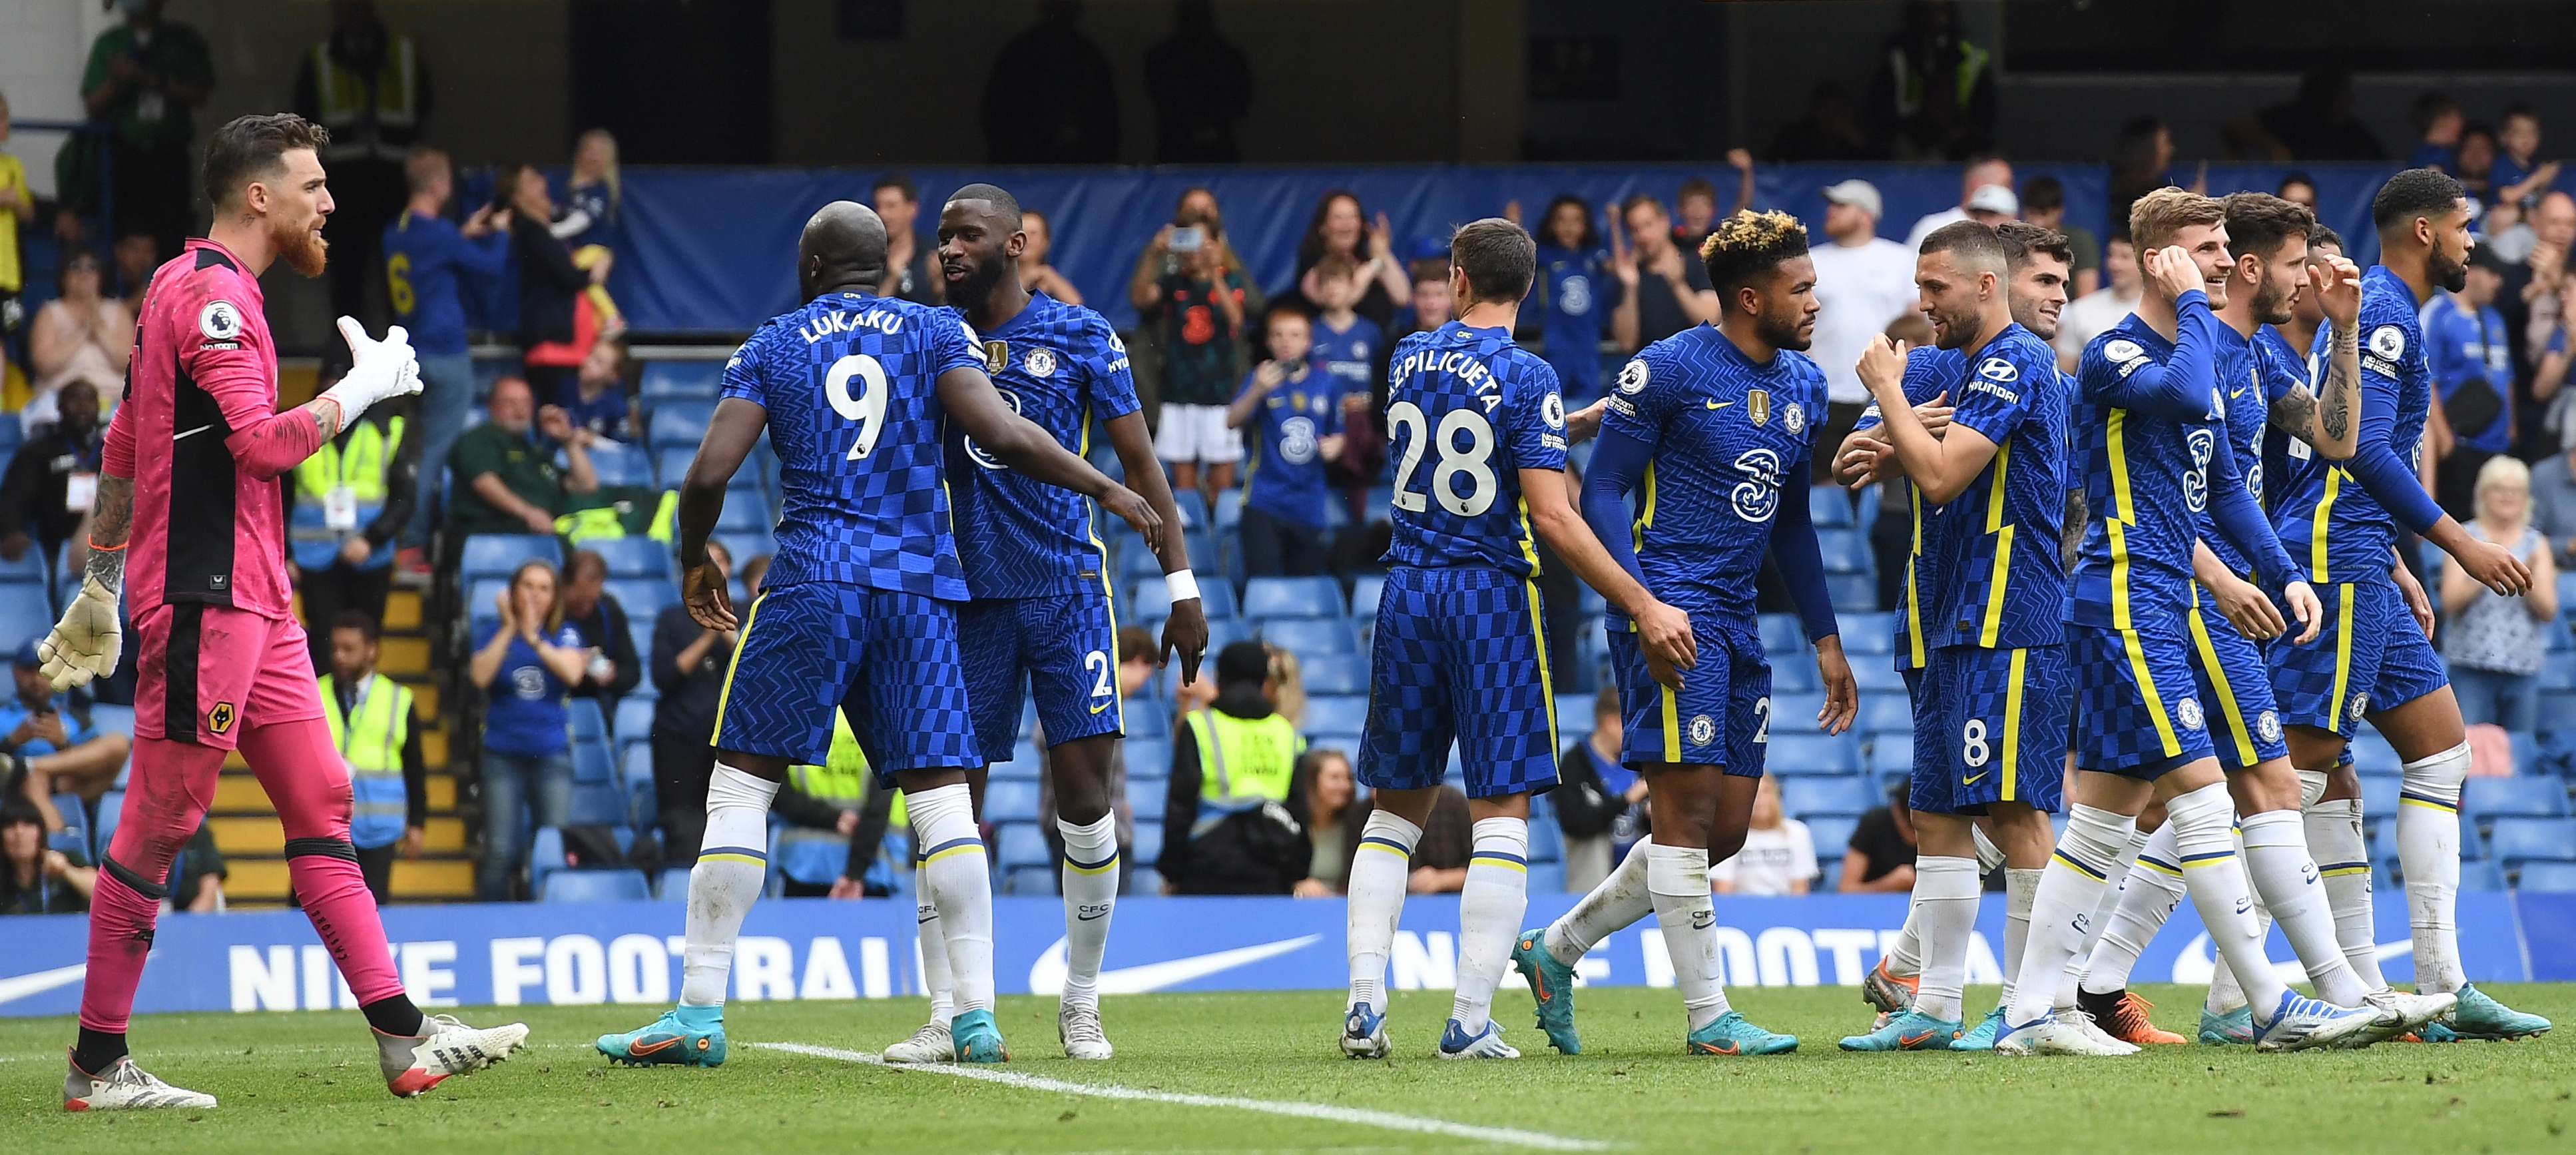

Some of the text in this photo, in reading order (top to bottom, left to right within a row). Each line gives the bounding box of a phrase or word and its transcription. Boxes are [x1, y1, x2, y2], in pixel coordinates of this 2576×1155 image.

[387, 253, 415, 314] 6
[799, 310, 903, 344] LUKAKU
[2376, 360, 2396, 371] room
[825, 354, 888, 461] 9
[1617, 398, 1634, 410] room
[1968, 380, 2019, 404] HYUNDAI
[1387, 401, 1497, 517] 28
[1085, 650, 1113, 697] 2
[1963, 719, 1989, 767] 8
[1079, 904, 1109, 913] CFC
